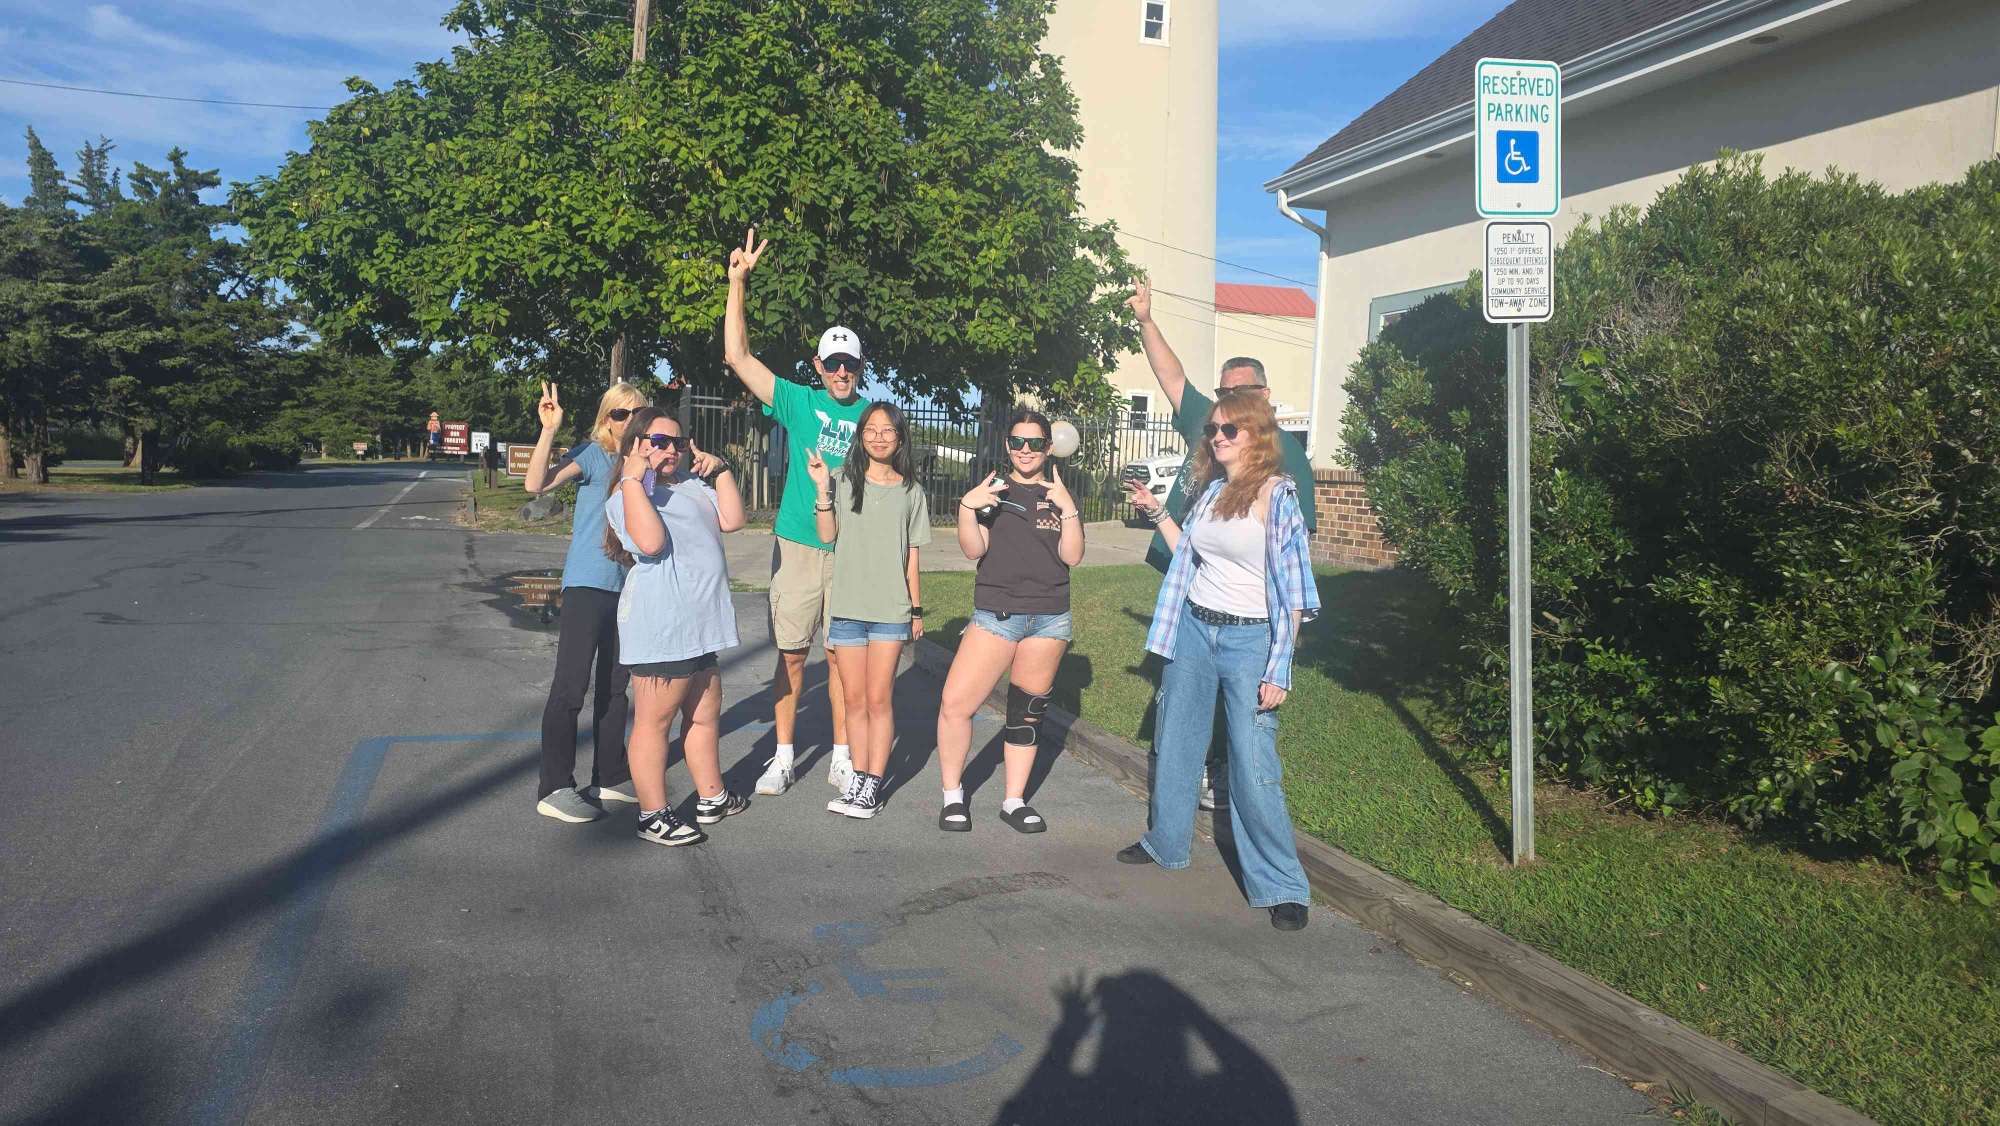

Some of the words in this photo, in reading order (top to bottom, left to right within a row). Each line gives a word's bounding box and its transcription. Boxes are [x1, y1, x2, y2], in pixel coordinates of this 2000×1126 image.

[1482, 75, 1554, 97] RESERVED
[1487, 102, 1549, 123] PARKING
[1502, 233, 1534, 242] PENALTY
[1518, 247, 1544, 255] OFFENSE
[1490, 256, 1520, 265] SUBSEQUENT
[1523, 256, 1547, 265] OFFENSES
[1497, 278, 1505, 286] UP
[1507, 278, 1514, 286] TO
[1490, 287, 1522, 296] COMMUNITY
[1524, 287, 1547, 295] SERVICE
[1490, 298, 1526, 308] TOW-AWAY
[1528, 297, 1548, 308] ZONE
